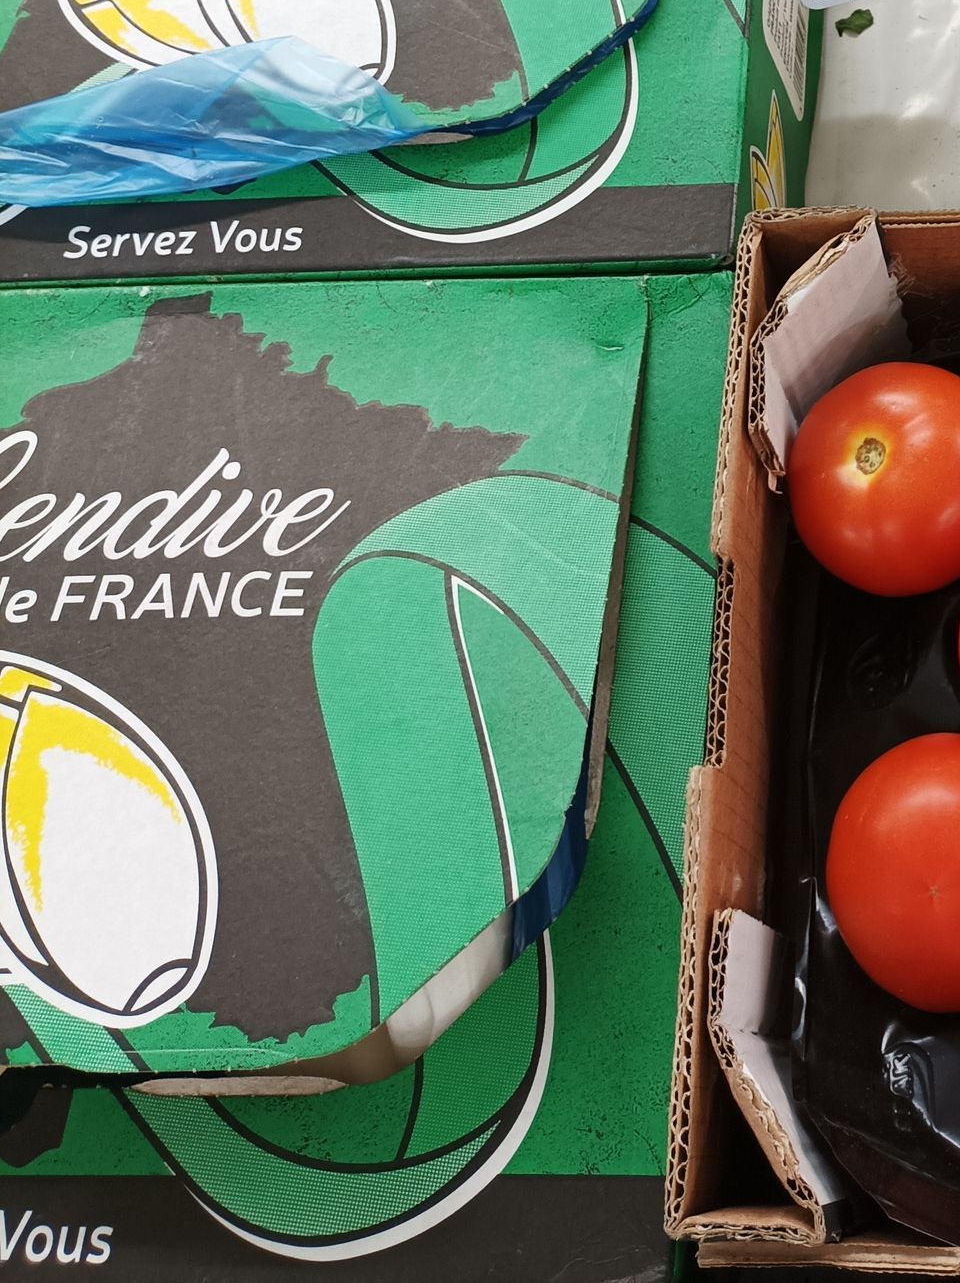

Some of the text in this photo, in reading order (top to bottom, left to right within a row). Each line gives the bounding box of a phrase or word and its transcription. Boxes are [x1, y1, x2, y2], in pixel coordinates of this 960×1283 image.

[62, 219, 303, 259] Servez Vous
[50, 570, 314, 622] FRANCE
[0, 1209, 114, 1264] Vous
